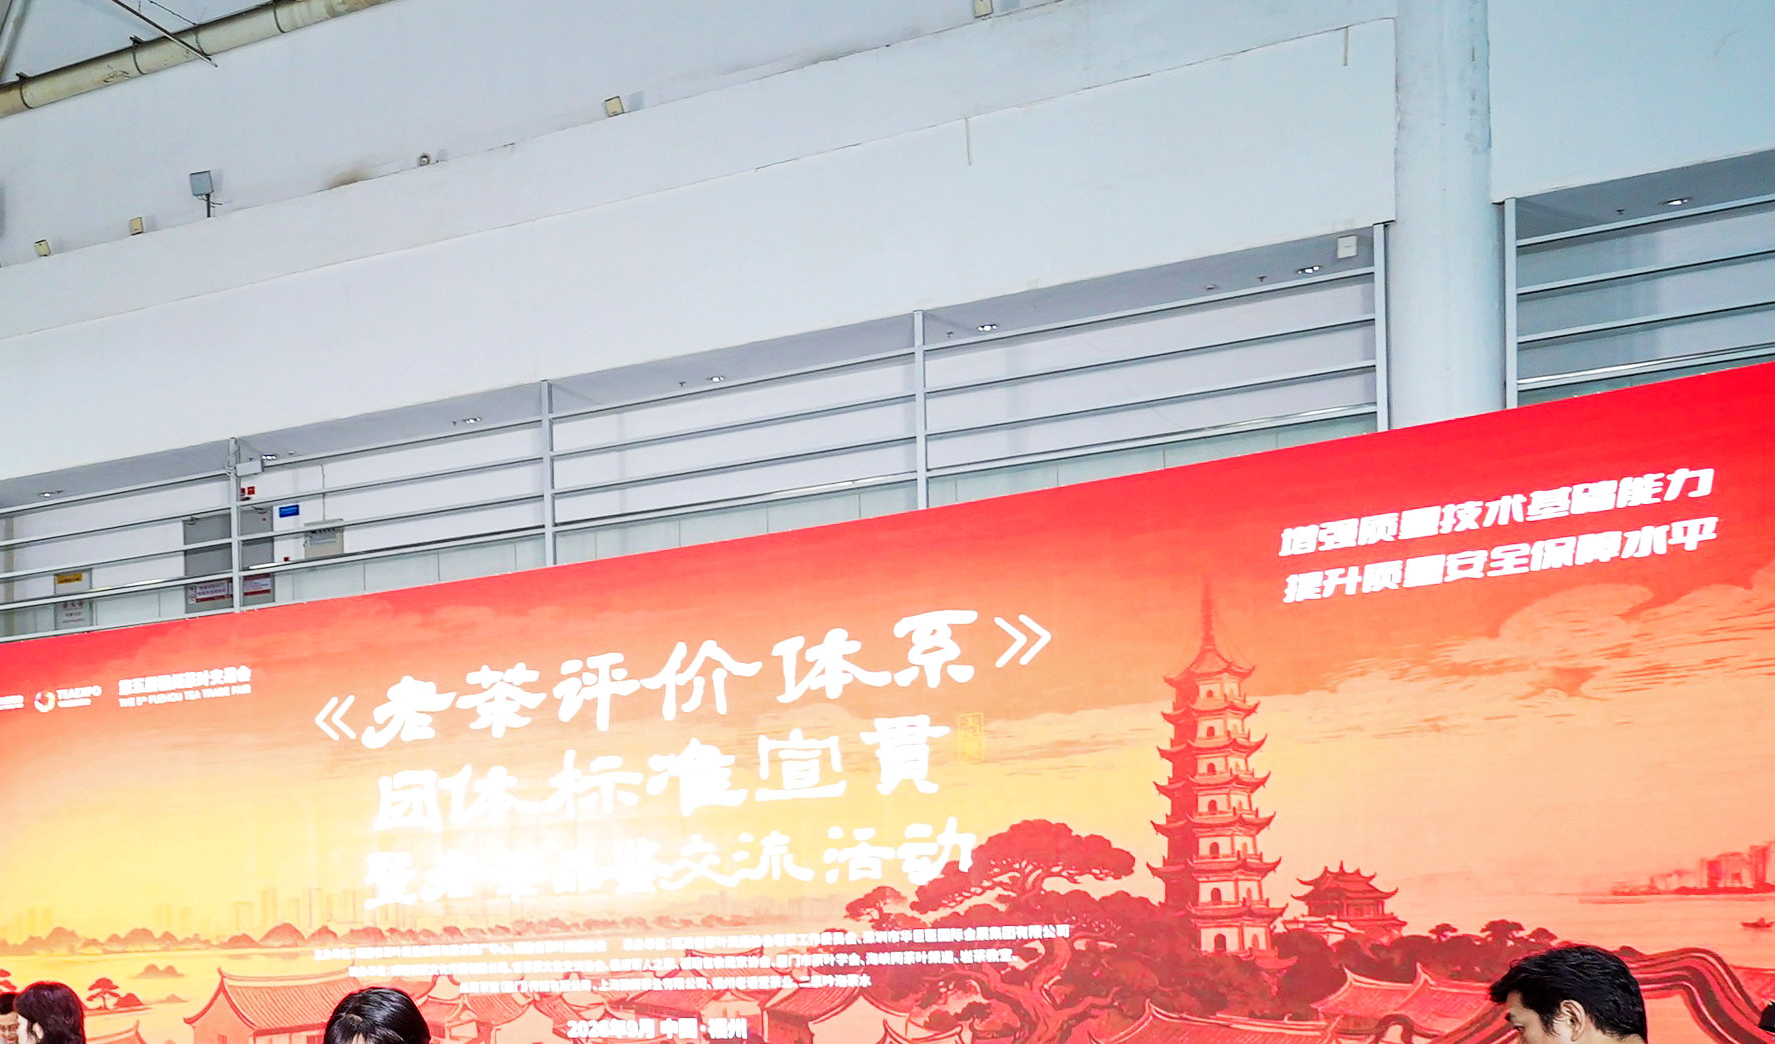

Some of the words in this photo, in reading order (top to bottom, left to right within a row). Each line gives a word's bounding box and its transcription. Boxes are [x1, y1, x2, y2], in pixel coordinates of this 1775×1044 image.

[1279, 468, 1715, 557] 增强质量技术基础能力
[1283, 516, 1719, 604] 提升质量安全保障水平
[314, 609, 1053, 749] 《老茶评价体系》
[372, 714, 950, 832] 团体标准宣贯
